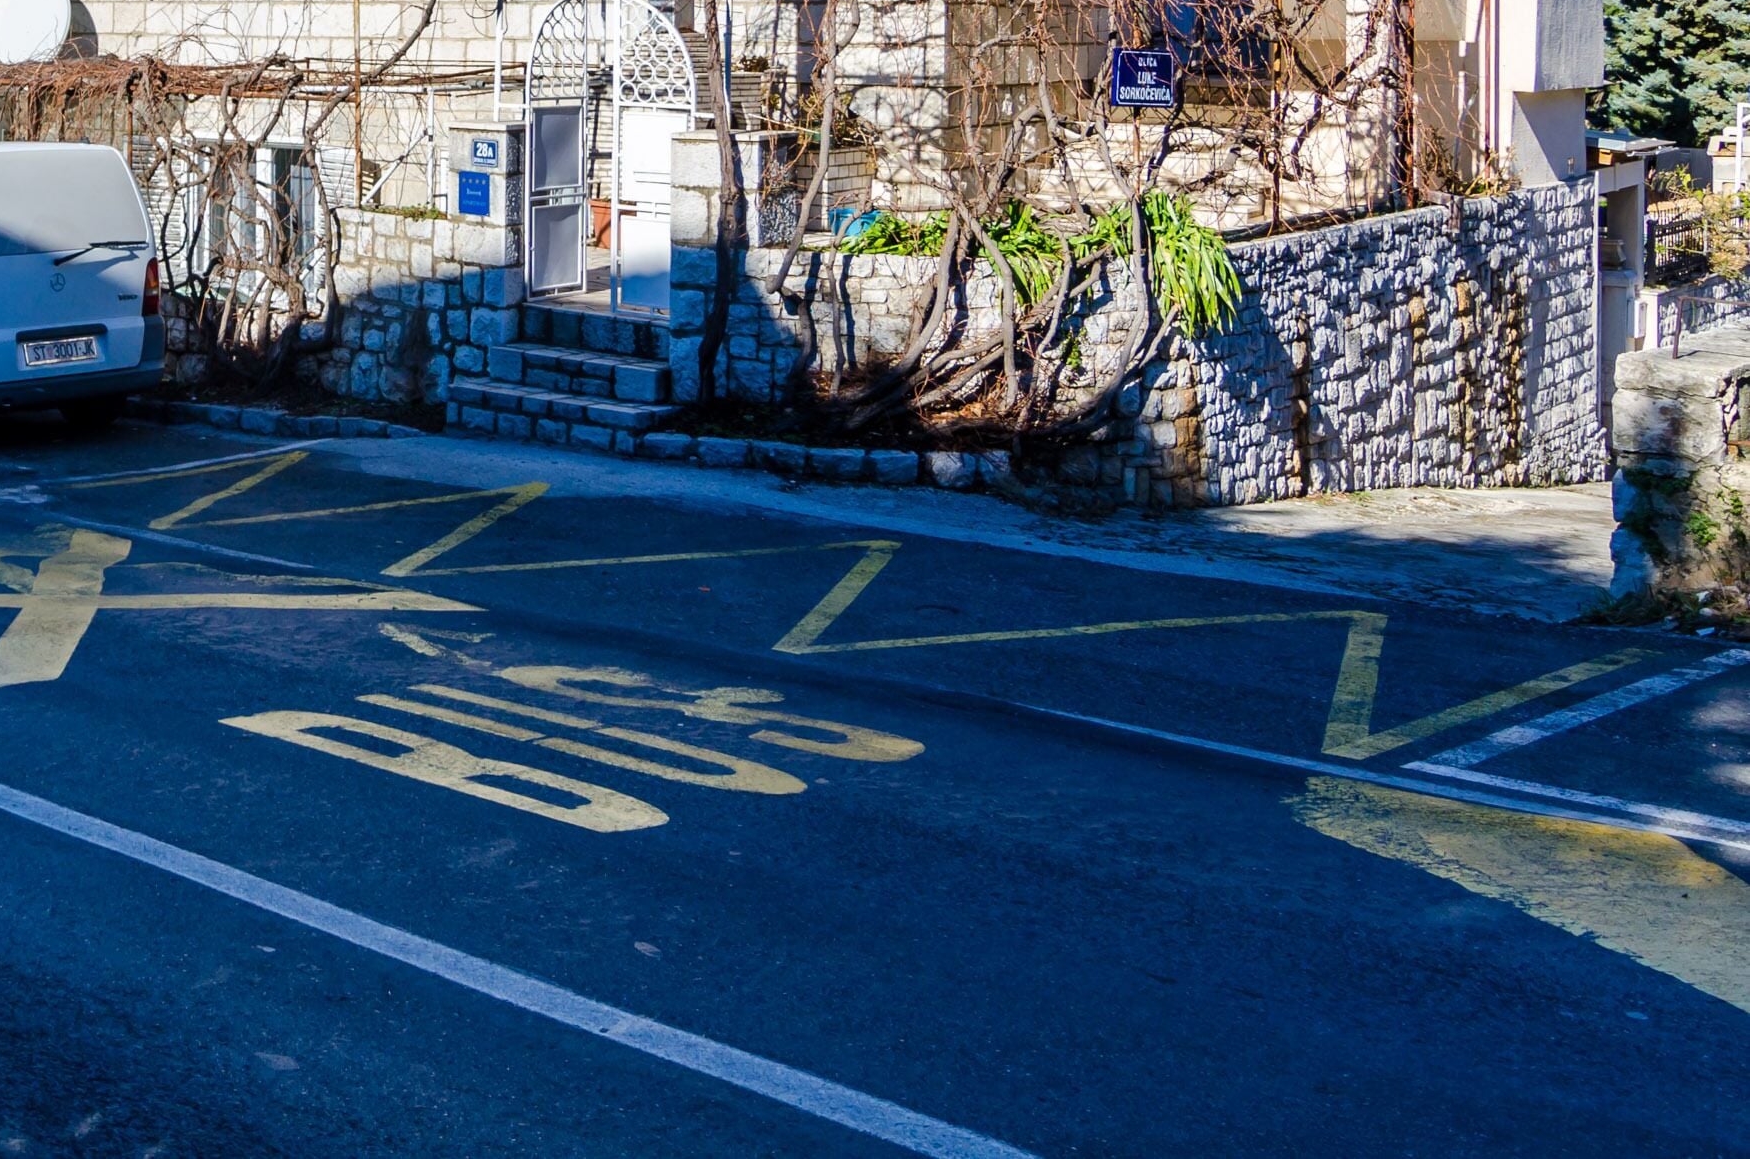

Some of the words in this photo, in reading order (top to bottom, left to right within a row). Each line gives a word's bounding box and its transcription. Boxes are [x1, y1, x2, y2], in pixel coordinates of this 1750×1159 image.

[1137, 56, 1158, 68] ULICA
[1137, 71, 1157, 85] LUKE
[476, 142, 494, 158] 28A
[33, 345, 46, 361] ST
[217, 665, 926, 834] BUS
